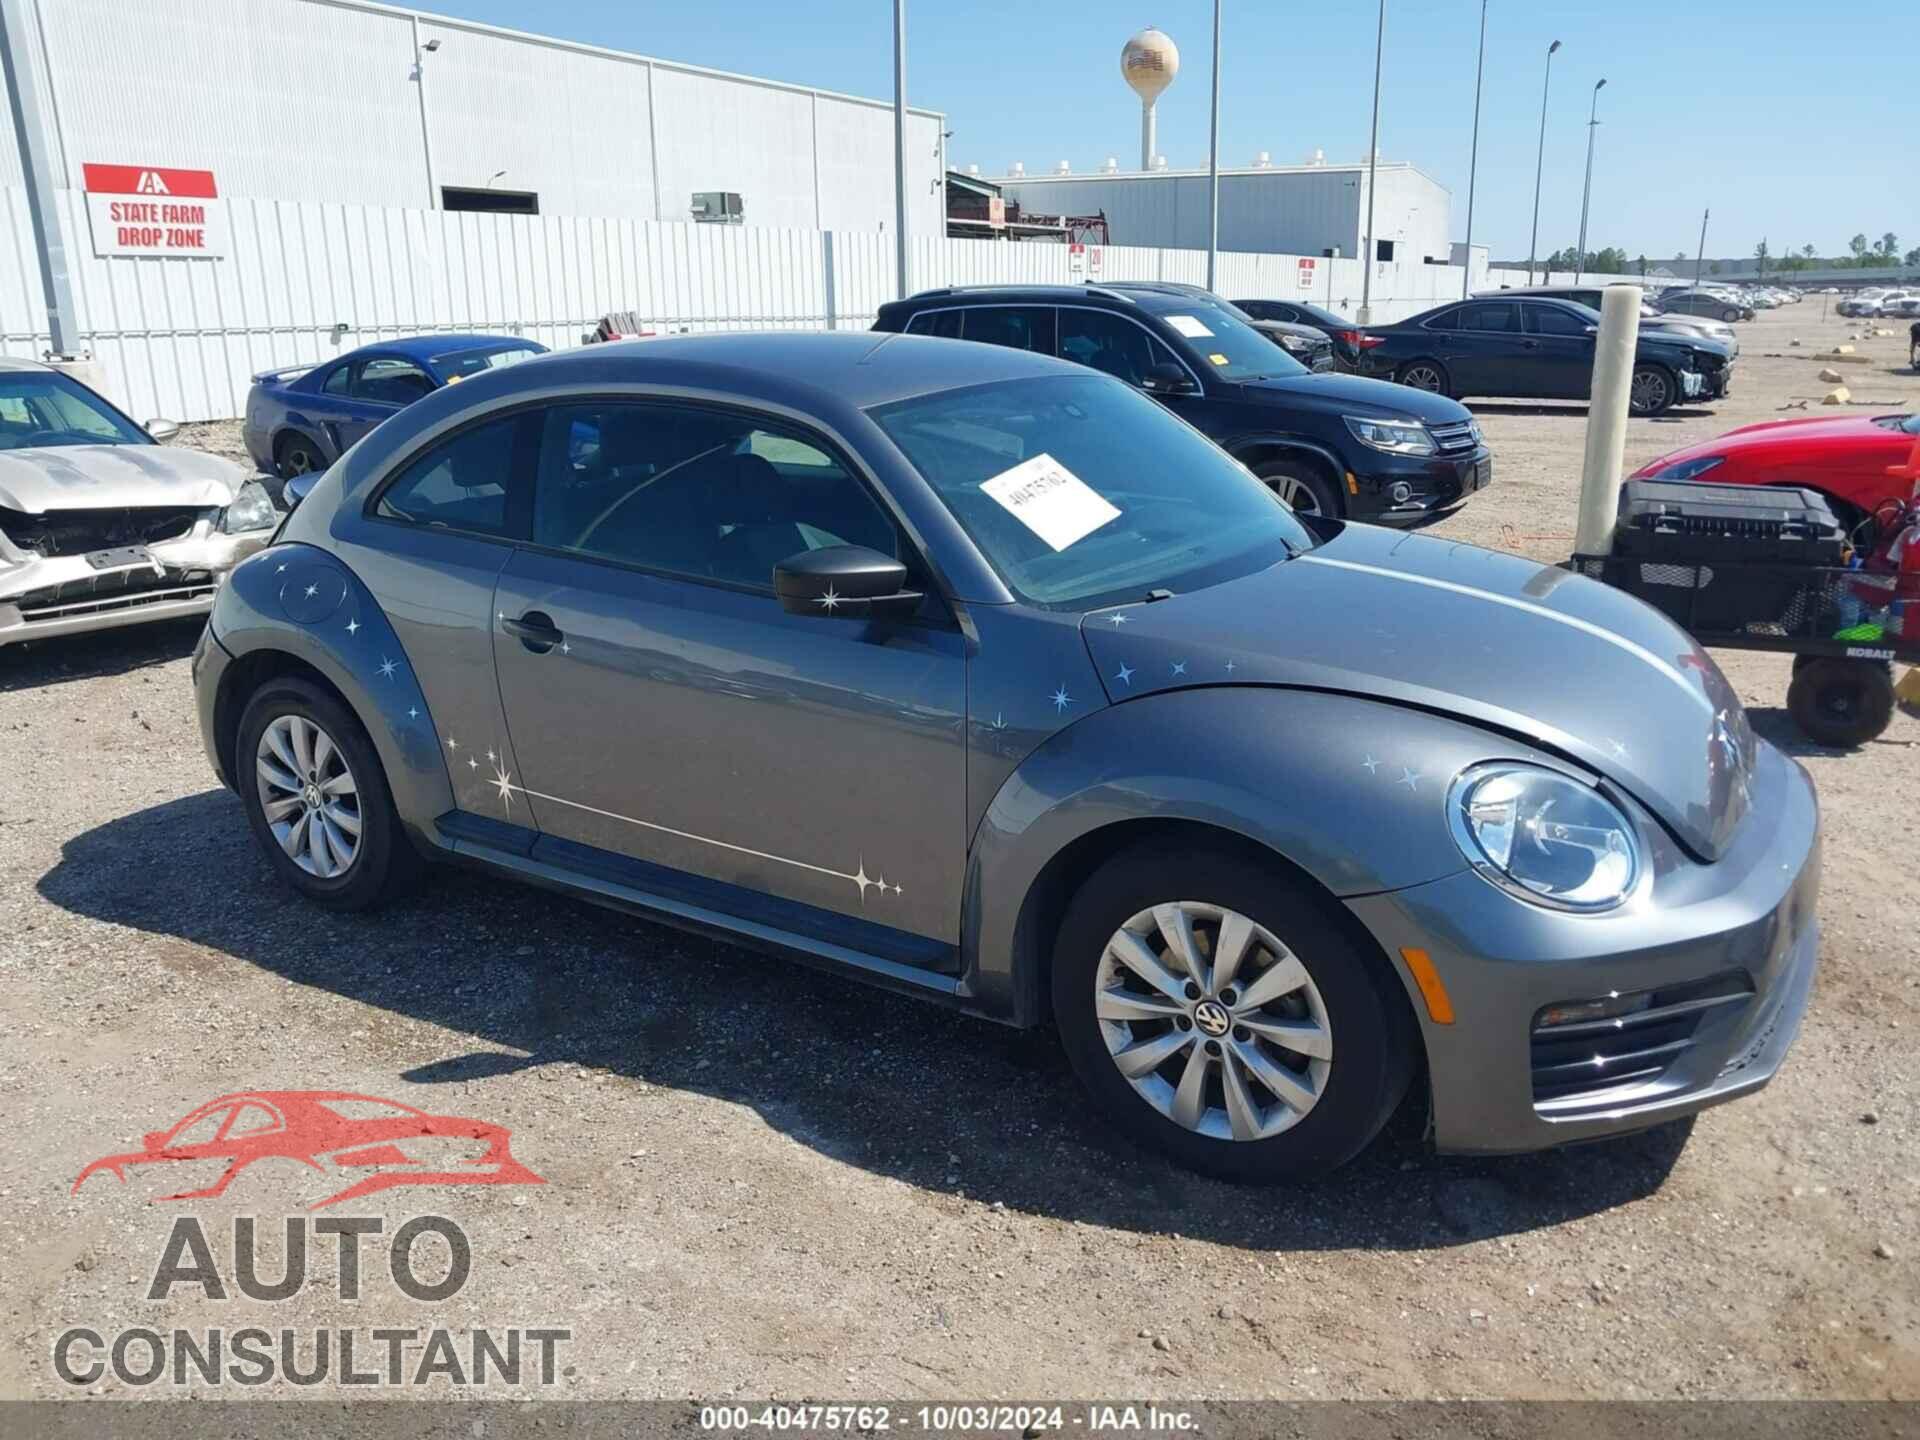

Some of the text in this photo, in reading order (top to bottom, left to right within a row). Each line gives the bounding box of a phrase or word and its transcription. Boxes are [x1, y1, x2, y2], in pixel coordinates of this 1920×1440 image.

[110, 202, 205, 224] STATE FARM
[117, 227, 205, 248] DROP ZONE
[1846, 647, 1896, 659] KOBALT
